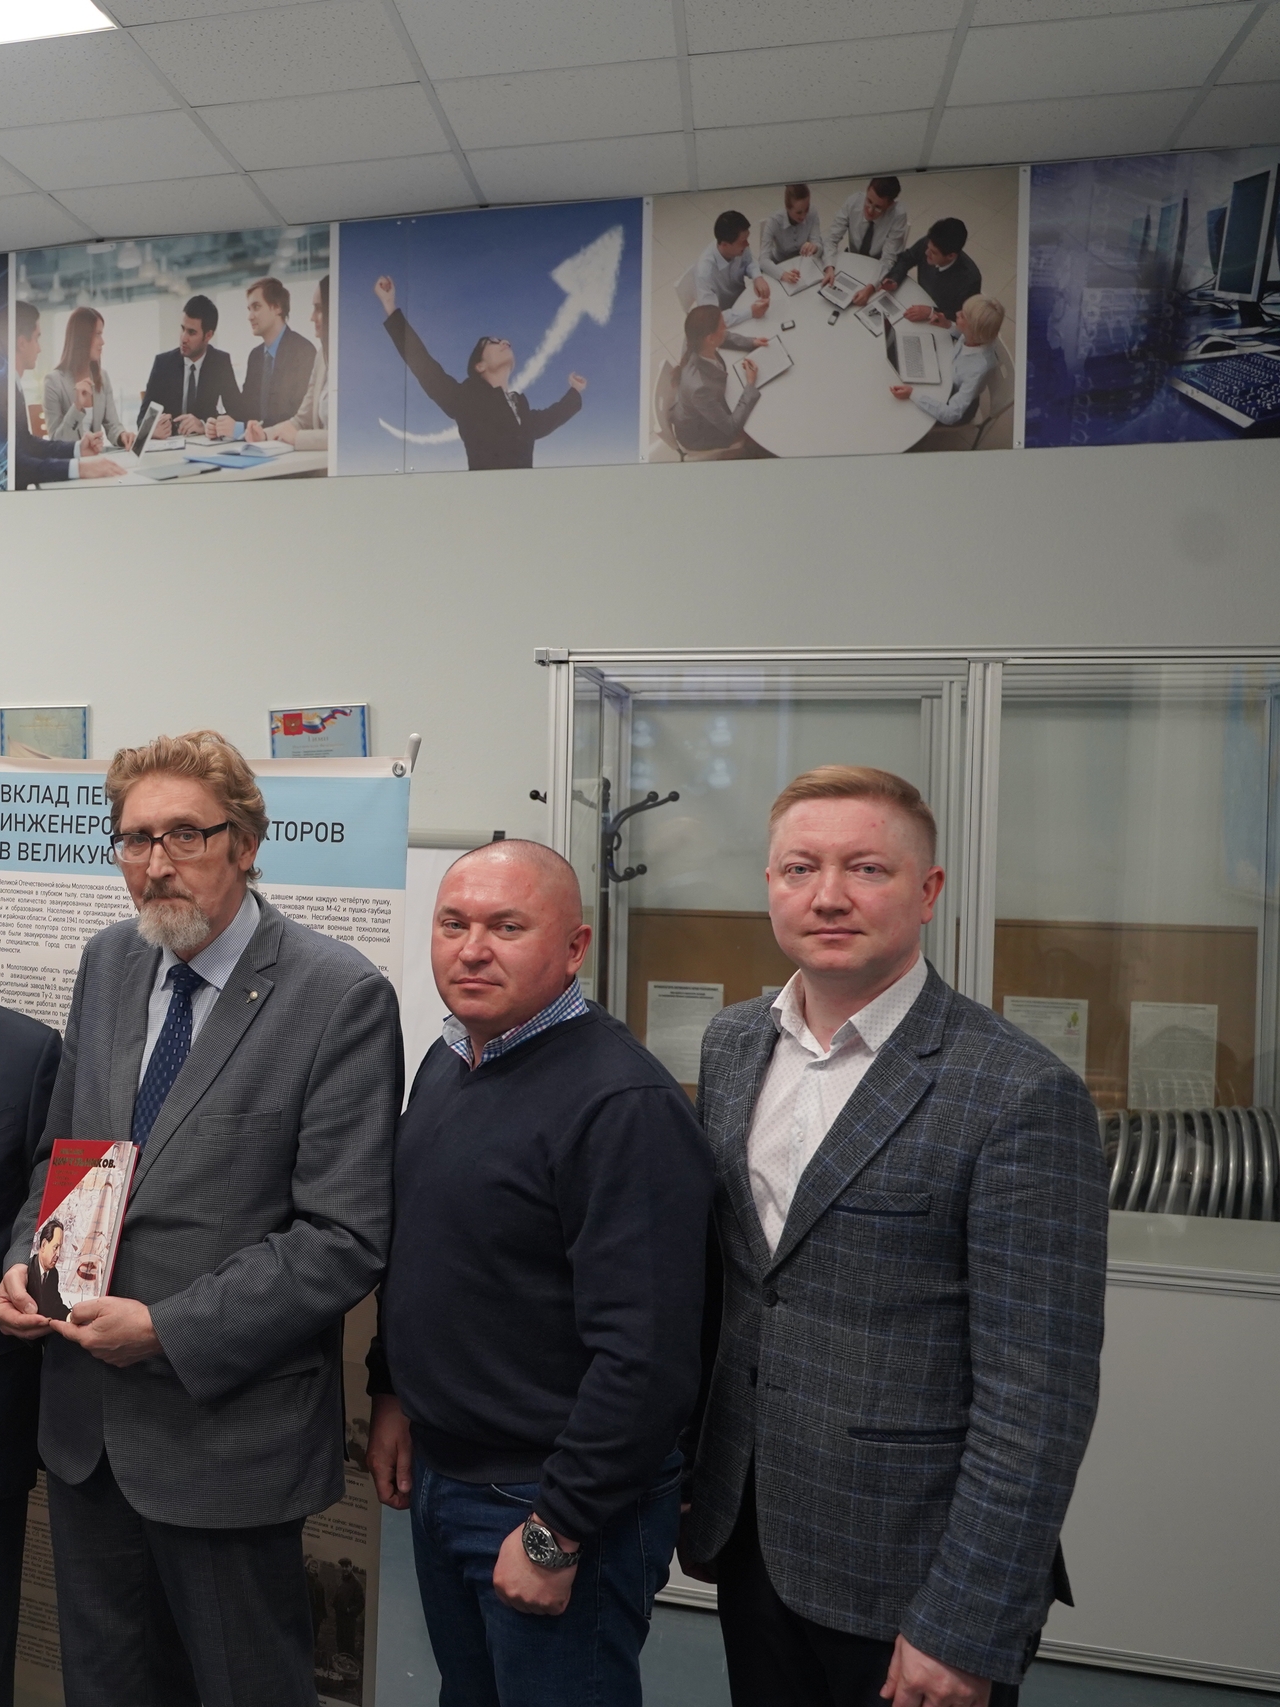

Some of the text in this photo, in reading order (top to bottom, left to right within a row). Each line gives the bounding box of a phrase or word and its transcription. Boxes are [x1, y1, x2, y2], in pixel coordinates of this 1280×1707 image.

[0, 784, 109, 808] ВКЛАД ПЕ
[0, 812, 345, 843] ИНЖЕНЕРО ТОРОВ
[0, 841, 115, 865] В ВЕЛИКУЮ
[348, 907, 392, 915] пушка-гаубица
[283, 912, 308, 921] Тиграм».
[311, 914, 350, 922] Несгибаемая
[357, 935, 390, 943] оборонной
[6, 963, 39, 973] Молотовскую
[41, 966, 60, 974] область
[10, 973, 47, 981] авиационные
[58, 986, 74, 994] выпус
[1, 996, 16, 1004] Рядом
